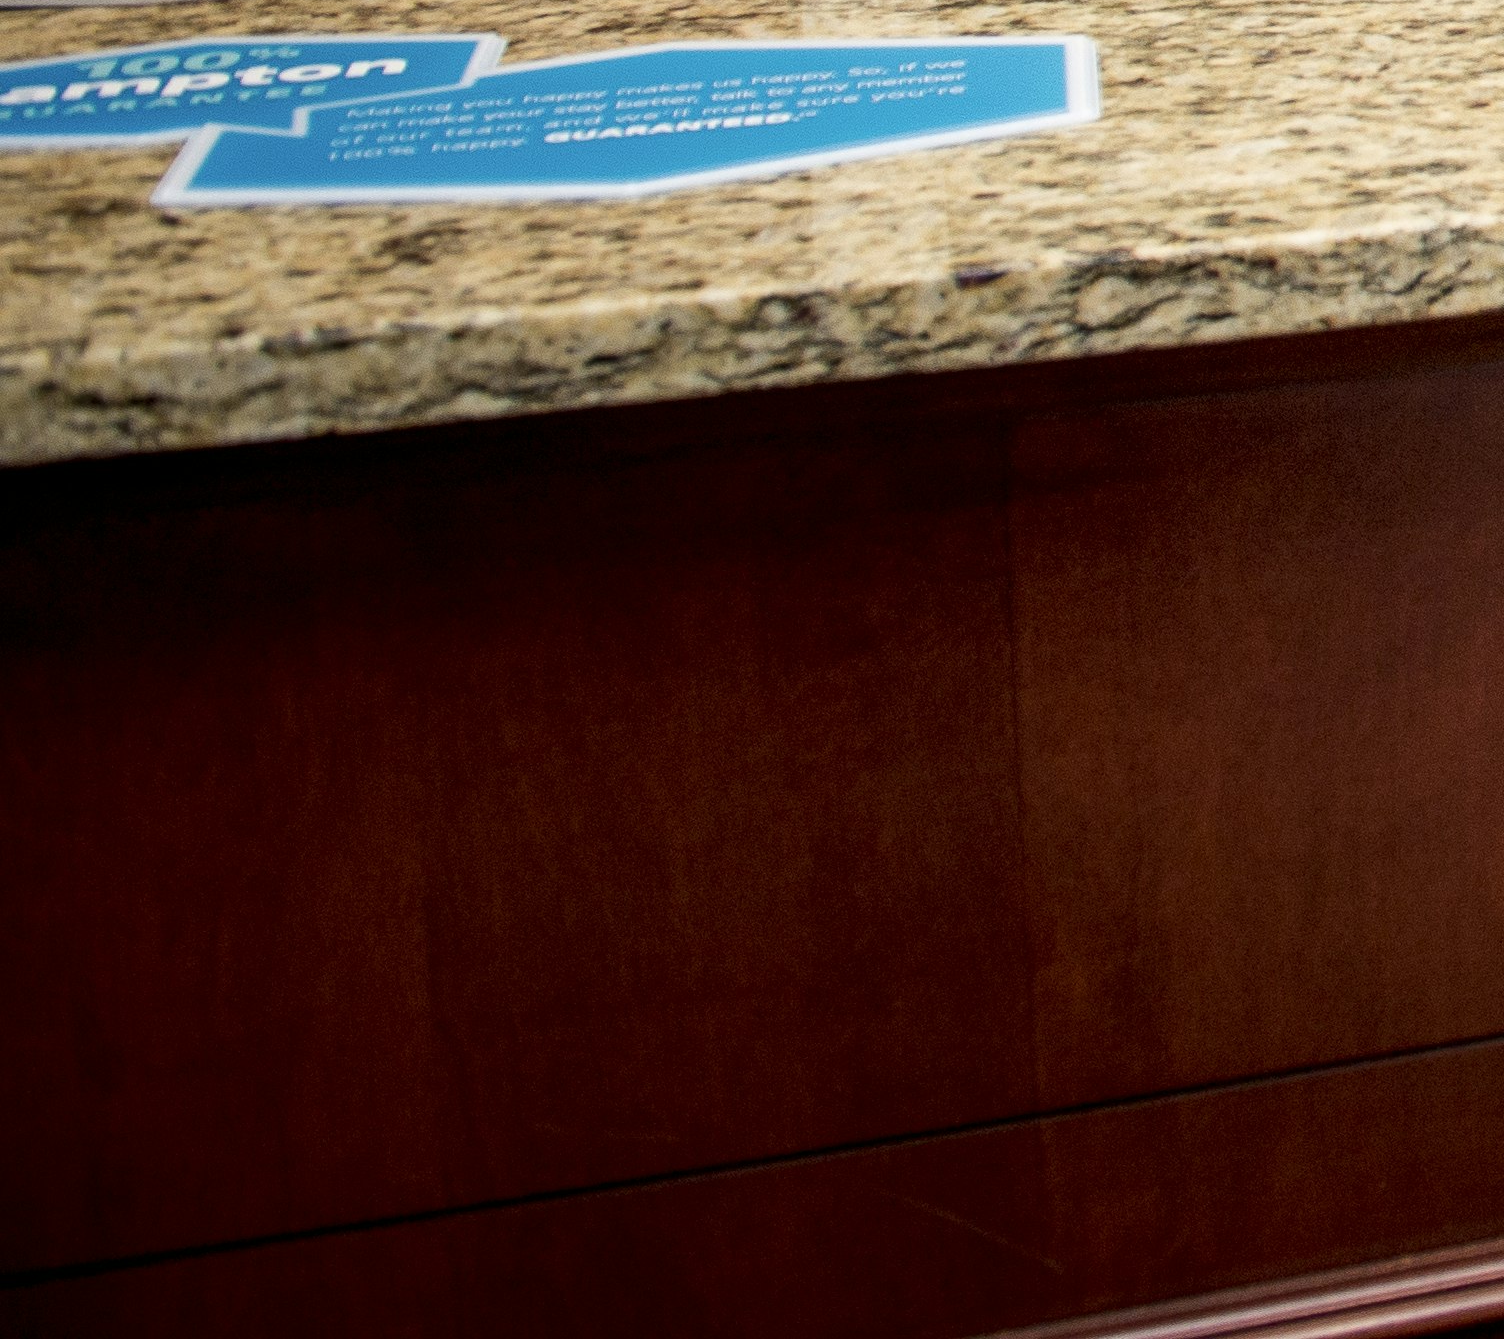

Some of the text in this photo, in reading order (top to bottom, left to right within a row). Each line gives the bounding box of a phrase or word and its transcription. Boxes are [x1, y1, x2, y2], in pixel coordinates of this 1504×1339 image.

[0, 59, 407, 105] ampton
[78, 46, 300, 78] 100%
[464, 98, 513, 110] you
[523, 89, 607, 104] happy
[616, 81, 703, 96] makes
[713, 78, 742, 88] us
[899, 61, 917, 72] if
[925, 59, 966, 70] we
[330, 134, 363, 148] of
[376, 131, 430, 144] our
[544, 115, 603, 129] and
[702, 102, 784, 115] make
[797, 94, 859, 108] sure
[338, 121, 388, 133] can
[398, 113, 475, 128] make
[484, 108, 545, 122] your
[554, 102, 607, 116] stay
[712, 89, 757, 102] talk
[767, 86, 795, 97] to
[801, 82, 849, 95] any
[858, 72, 966, 90] member
